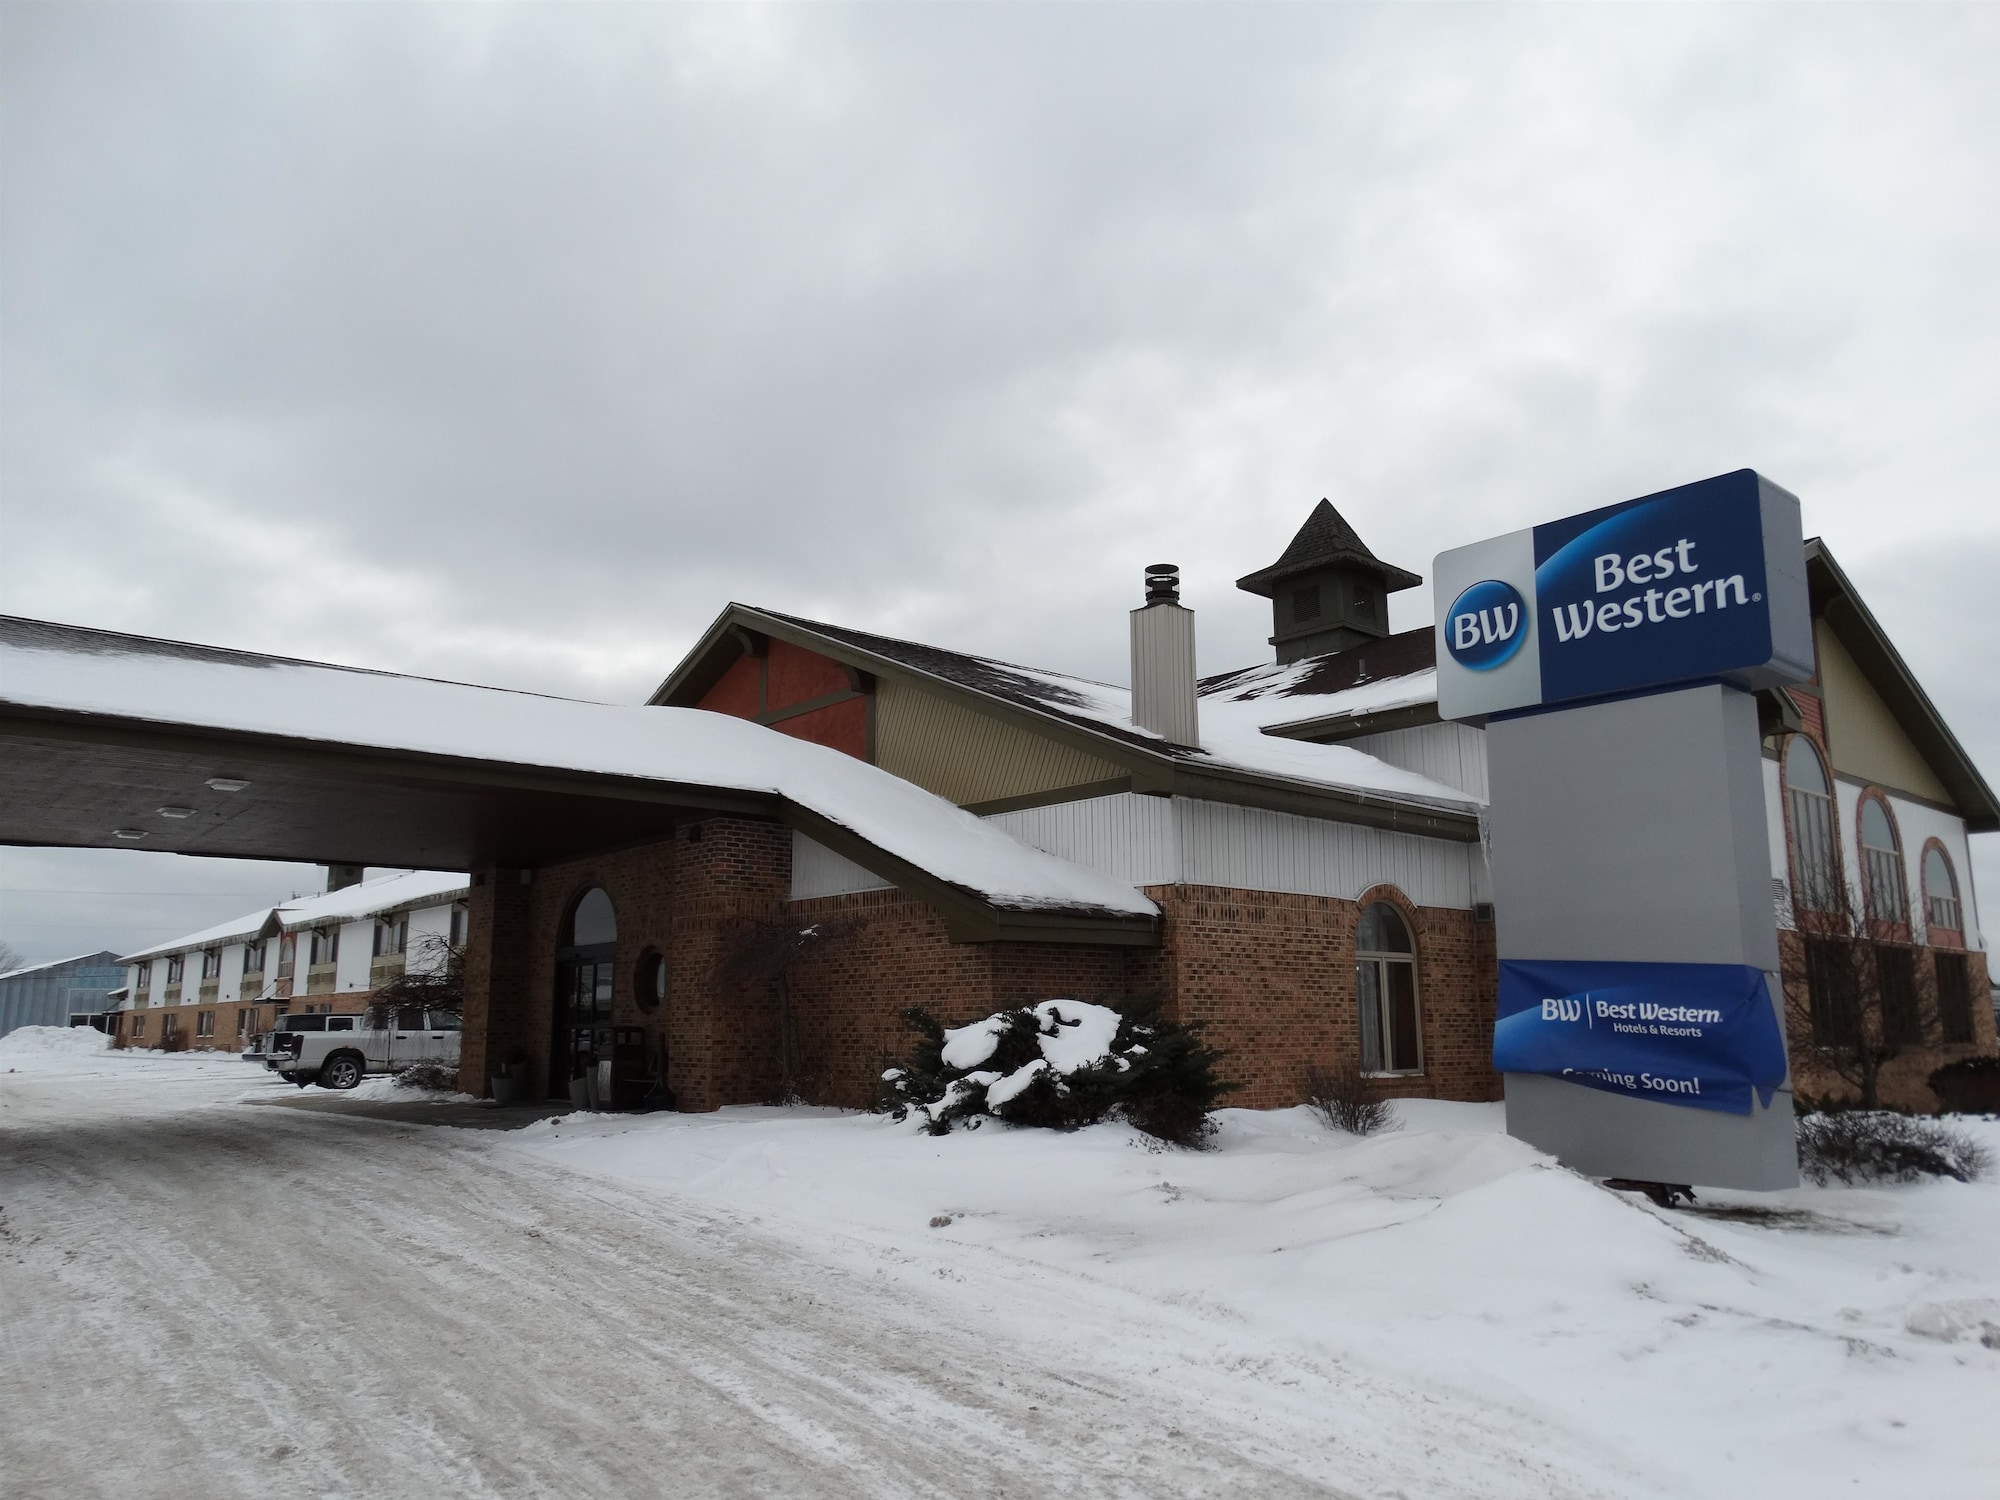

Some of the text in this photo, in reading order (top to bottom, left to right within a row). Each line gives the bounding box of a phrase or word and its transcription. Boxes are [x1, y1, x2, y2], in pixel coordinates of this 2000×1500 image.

[1594, 538, 1699, 594] Best
[1454, 602, 1519, 651] BW
[1552, 574, 1750, 643] Western
[1541, 998, 1719, 1023] BW Best Western
[1613, 1022, 1702, 1038] Hotels & Resorts
[1640, 1072, 1701, 1095] Soon!
